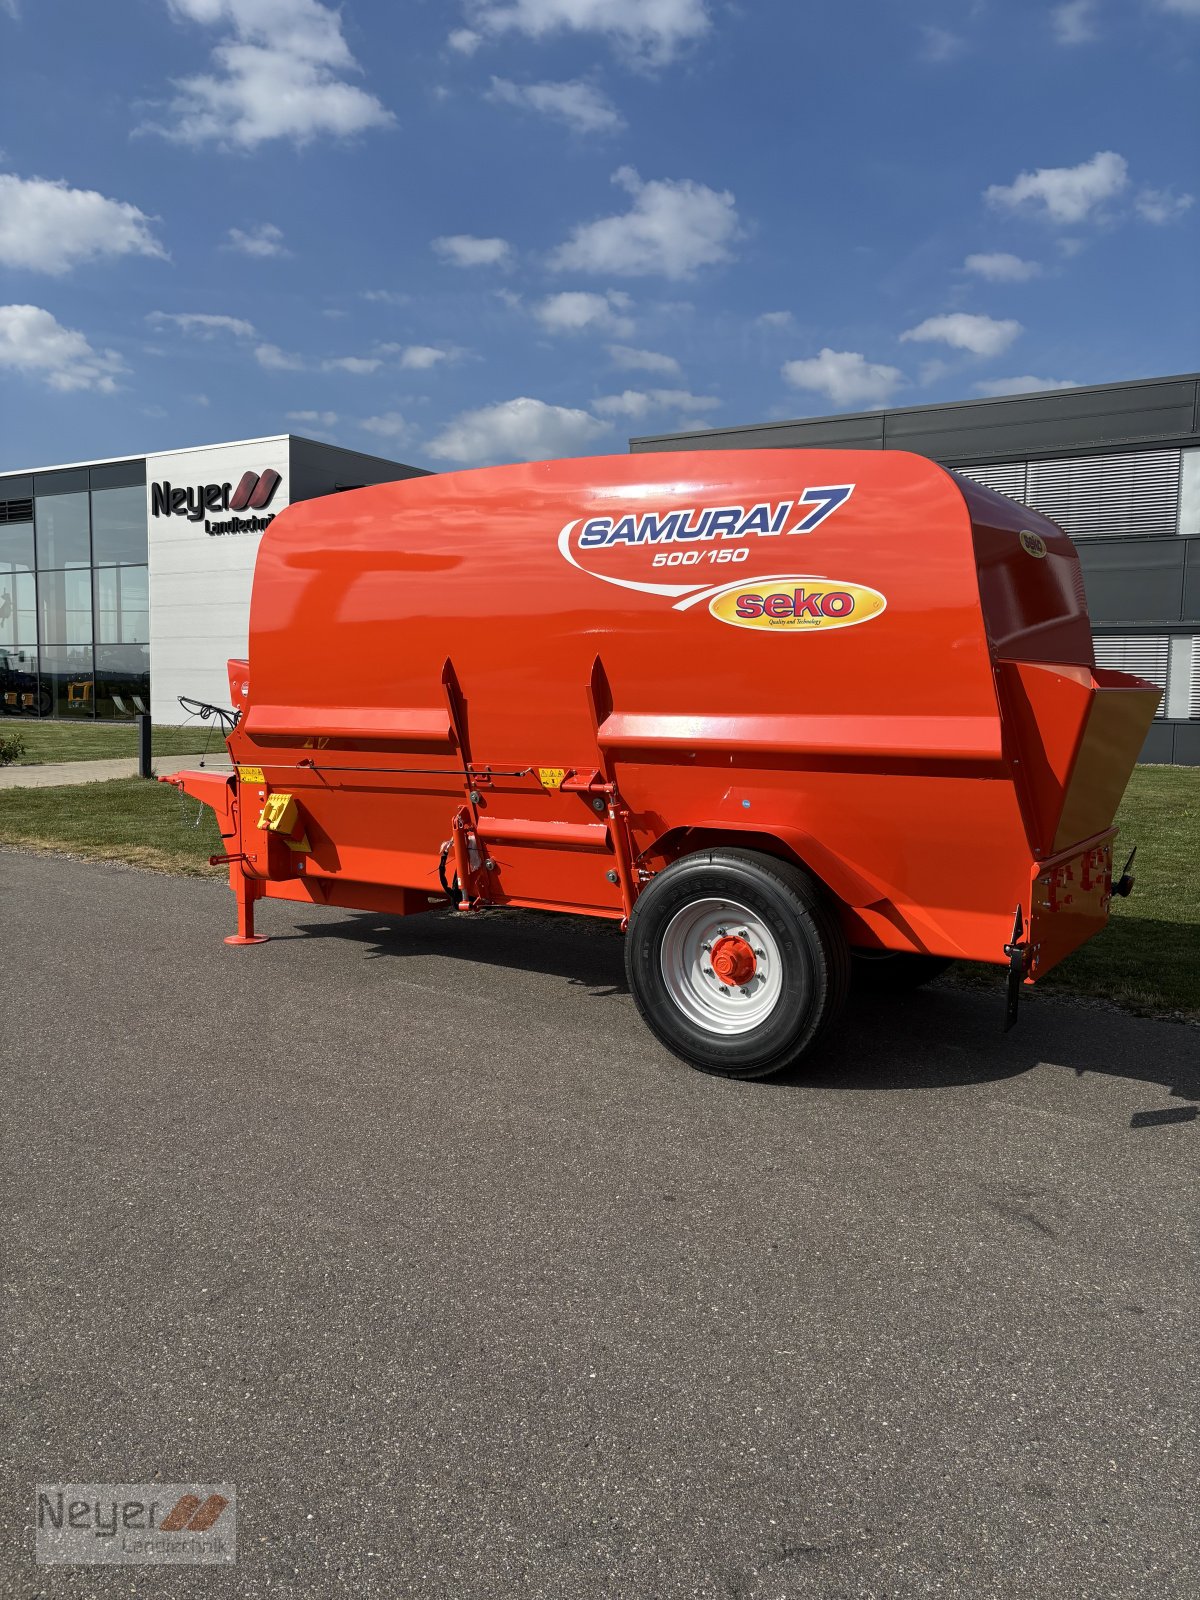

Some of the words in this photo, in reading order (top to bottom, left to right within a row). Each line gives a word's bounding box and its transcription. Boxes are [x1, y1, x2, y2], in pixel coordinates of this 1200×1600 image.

[152, 481, 232, 523] Neyer
[205, 513, 276, 536] Landtechni
[578, 501, 794, 549] SAMURAI
[787, 484, 856, 535] 7
[652, 548, 750, 567] 500/150
[736, 588, 855, 618] seko
[768, 618, 786, 626] Quality
[796, 618, 822, 626] Technology
